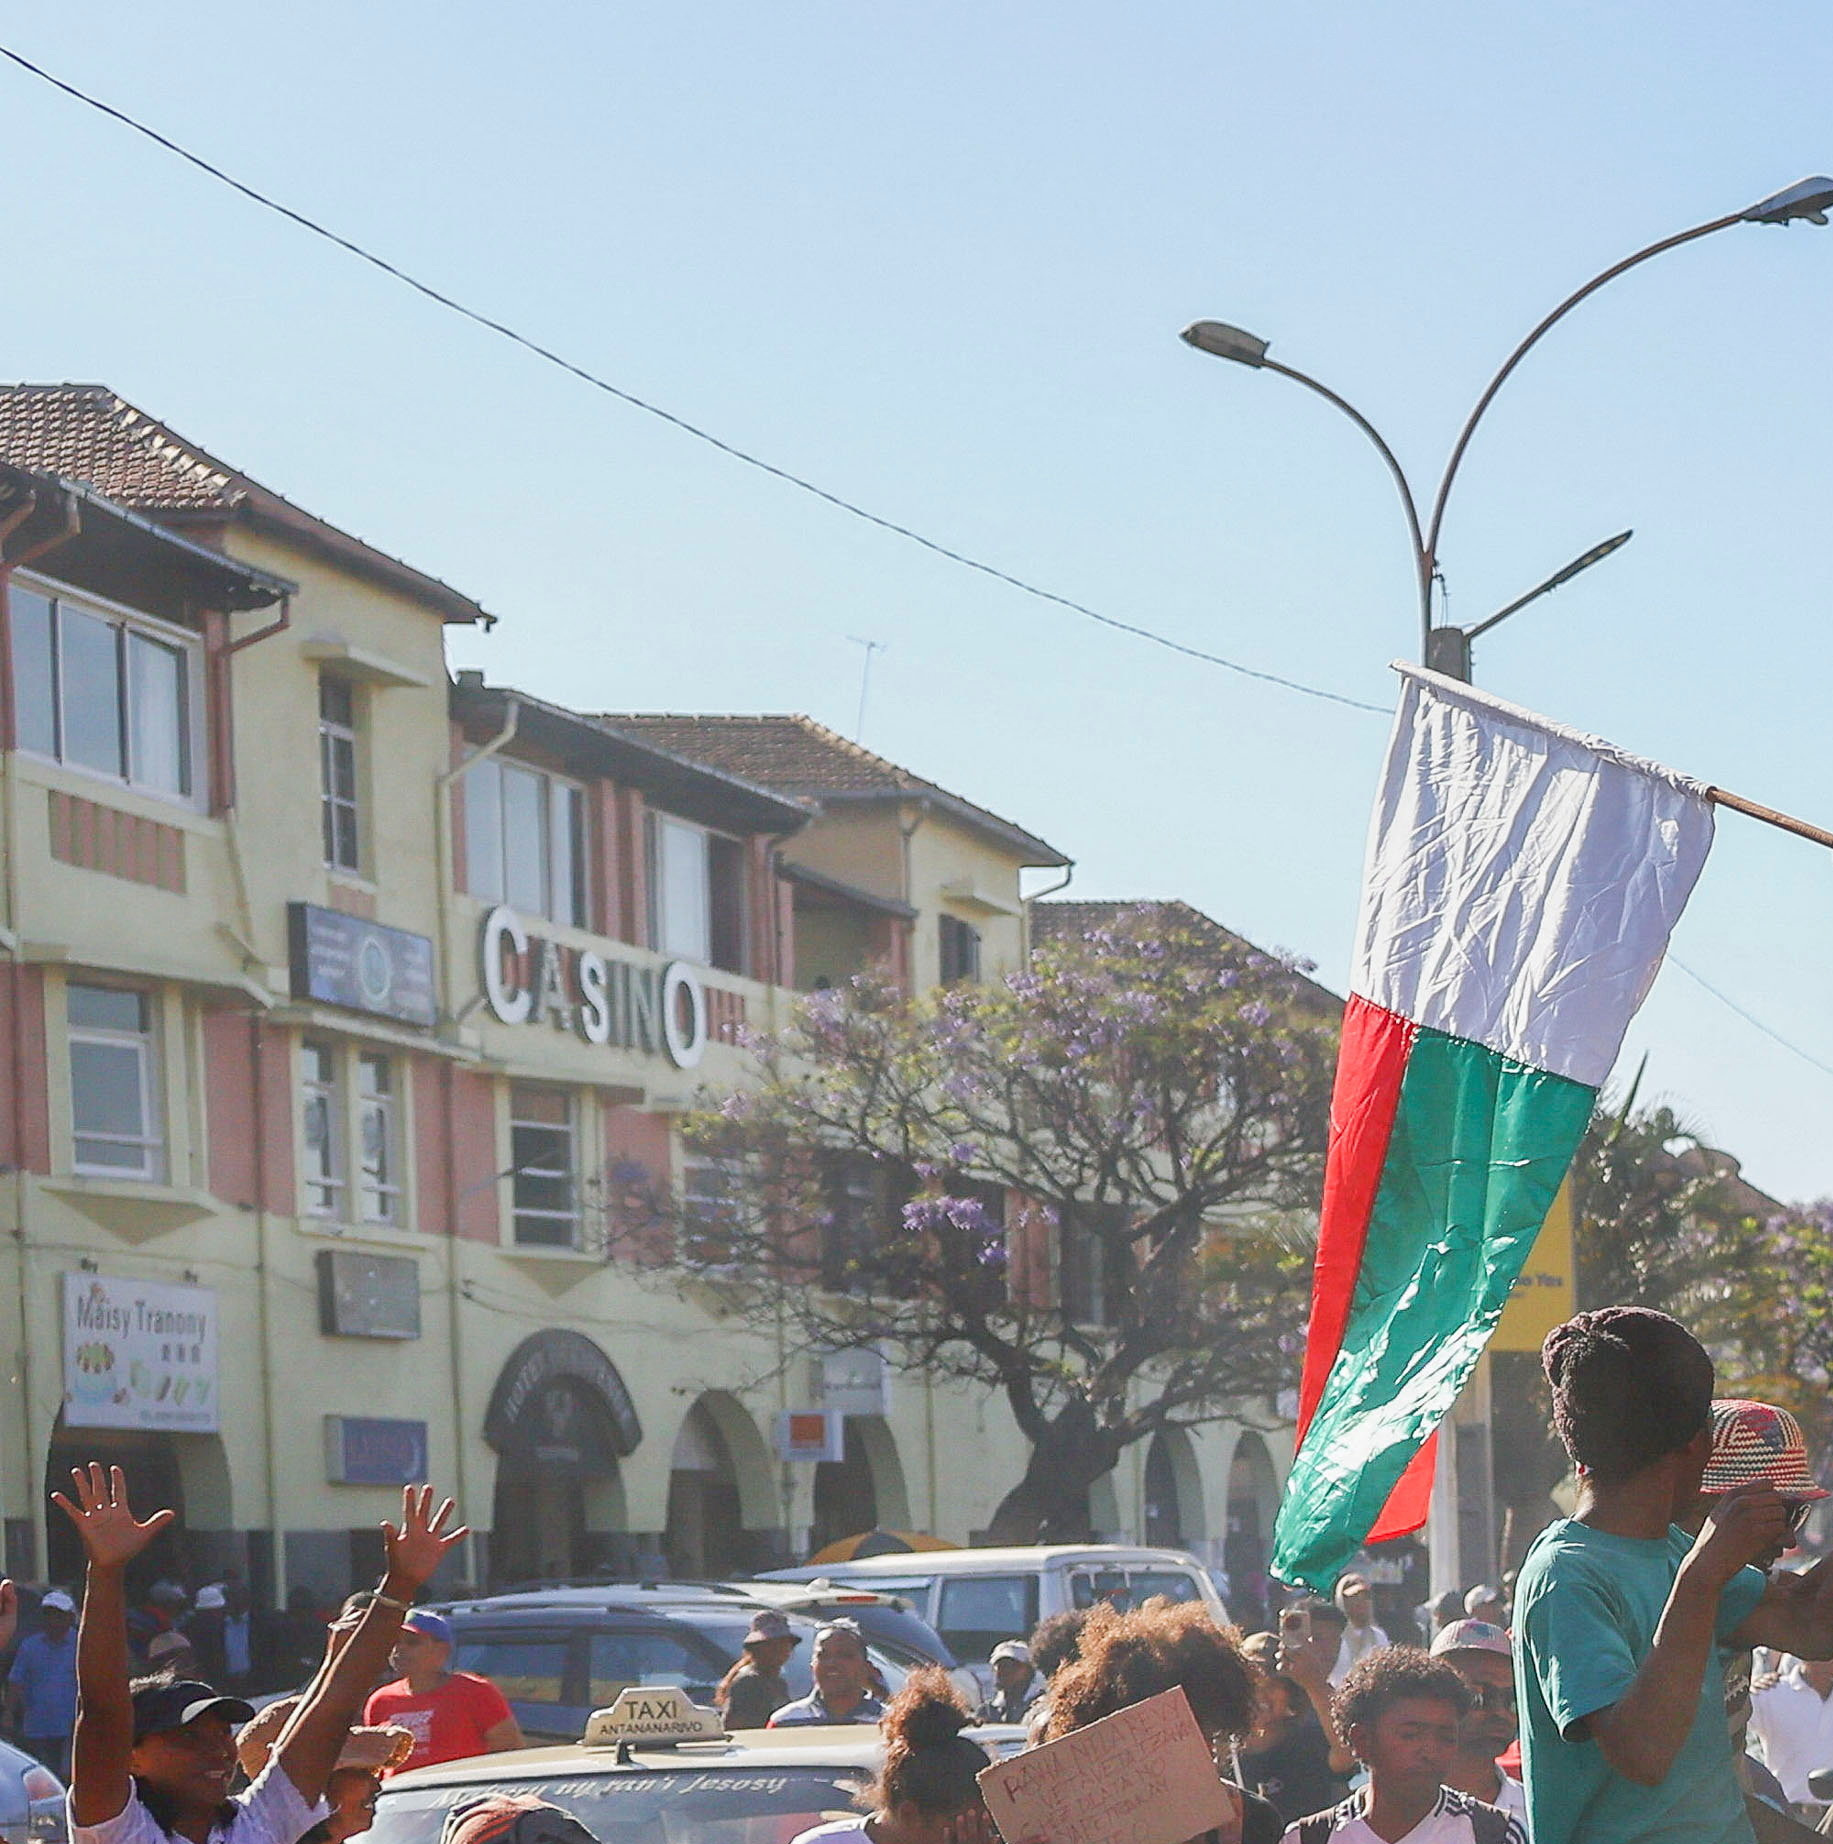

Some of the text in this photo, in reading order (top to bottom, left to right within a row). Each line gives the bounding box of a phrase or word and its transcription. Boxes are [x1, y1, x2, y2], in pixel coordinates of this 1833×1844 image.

[484, 904, 706, 1070] CASINO
[624, 1700, 677, 1720] TAXI
[600, 1720, 703, 1736] ANTANANARIVO
